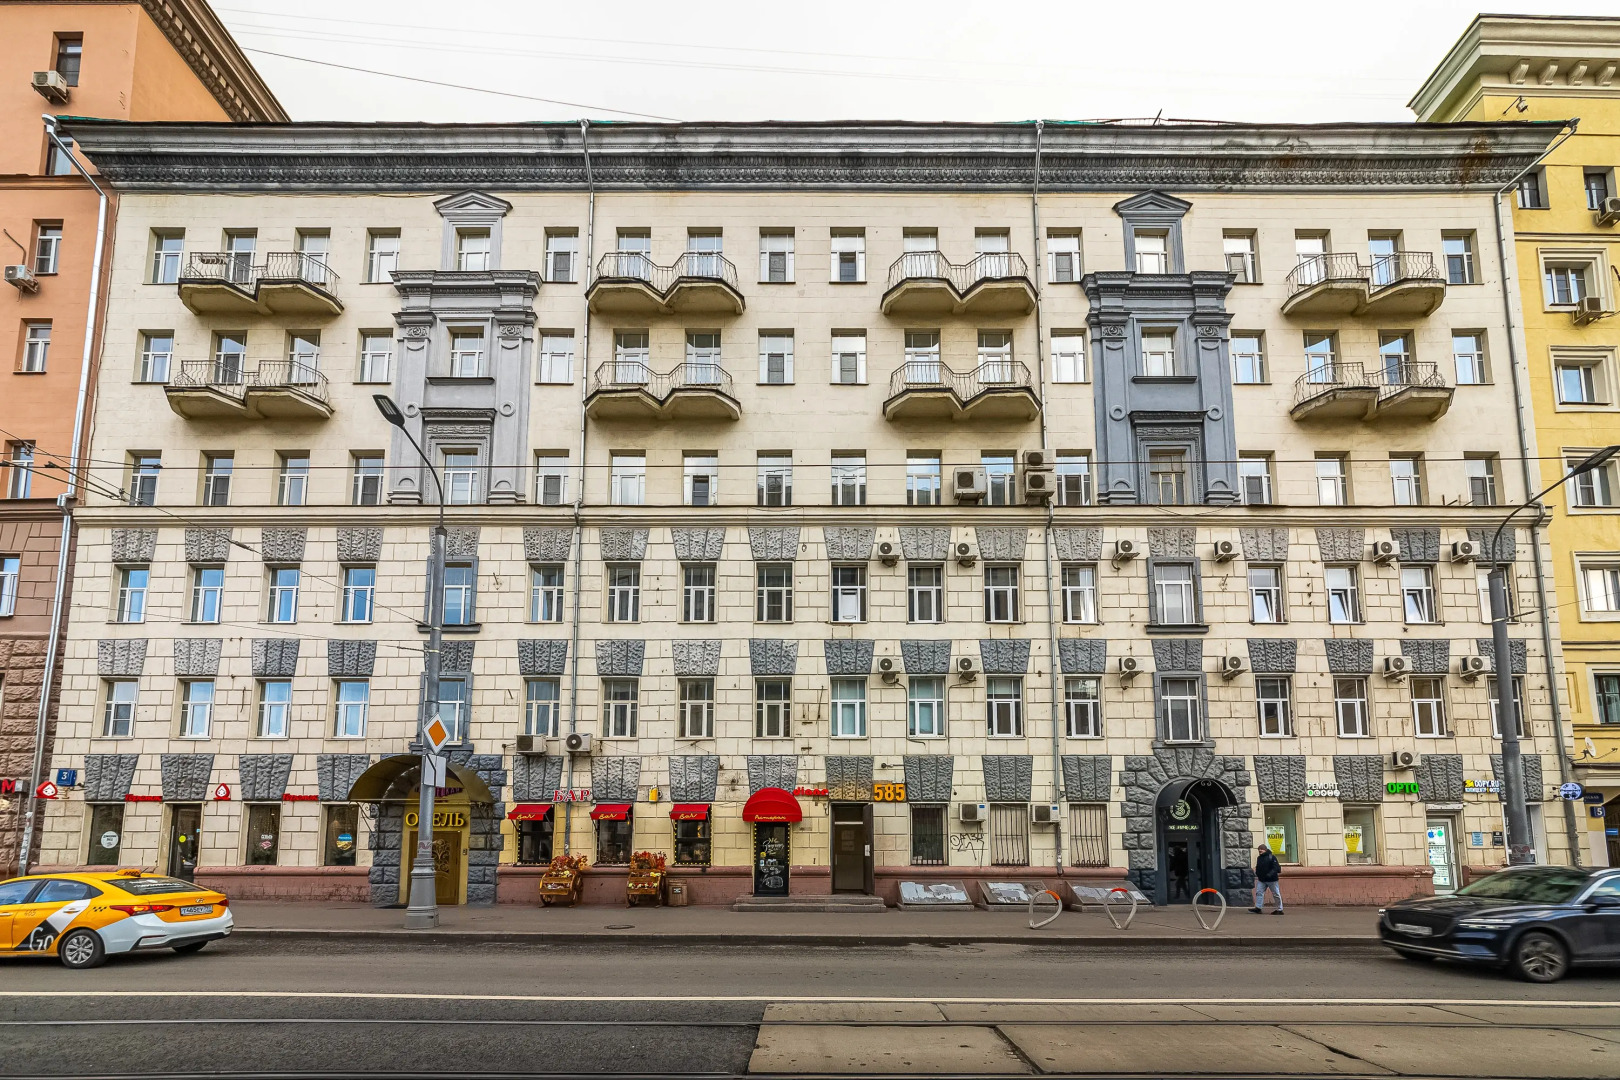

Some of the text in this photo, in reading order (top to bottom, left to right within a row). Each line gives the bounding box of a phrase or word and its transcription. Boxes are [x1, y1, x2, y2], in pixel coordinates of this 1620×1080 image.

[61, 771, 68, 779] 3
[874, 783, 905, 802] 585
[1306, 782, 1339, 790] РЕМОНТ
[552, 789, 590, 802] БАР
[405, 812, 465, 827] ОЕЛЬ
